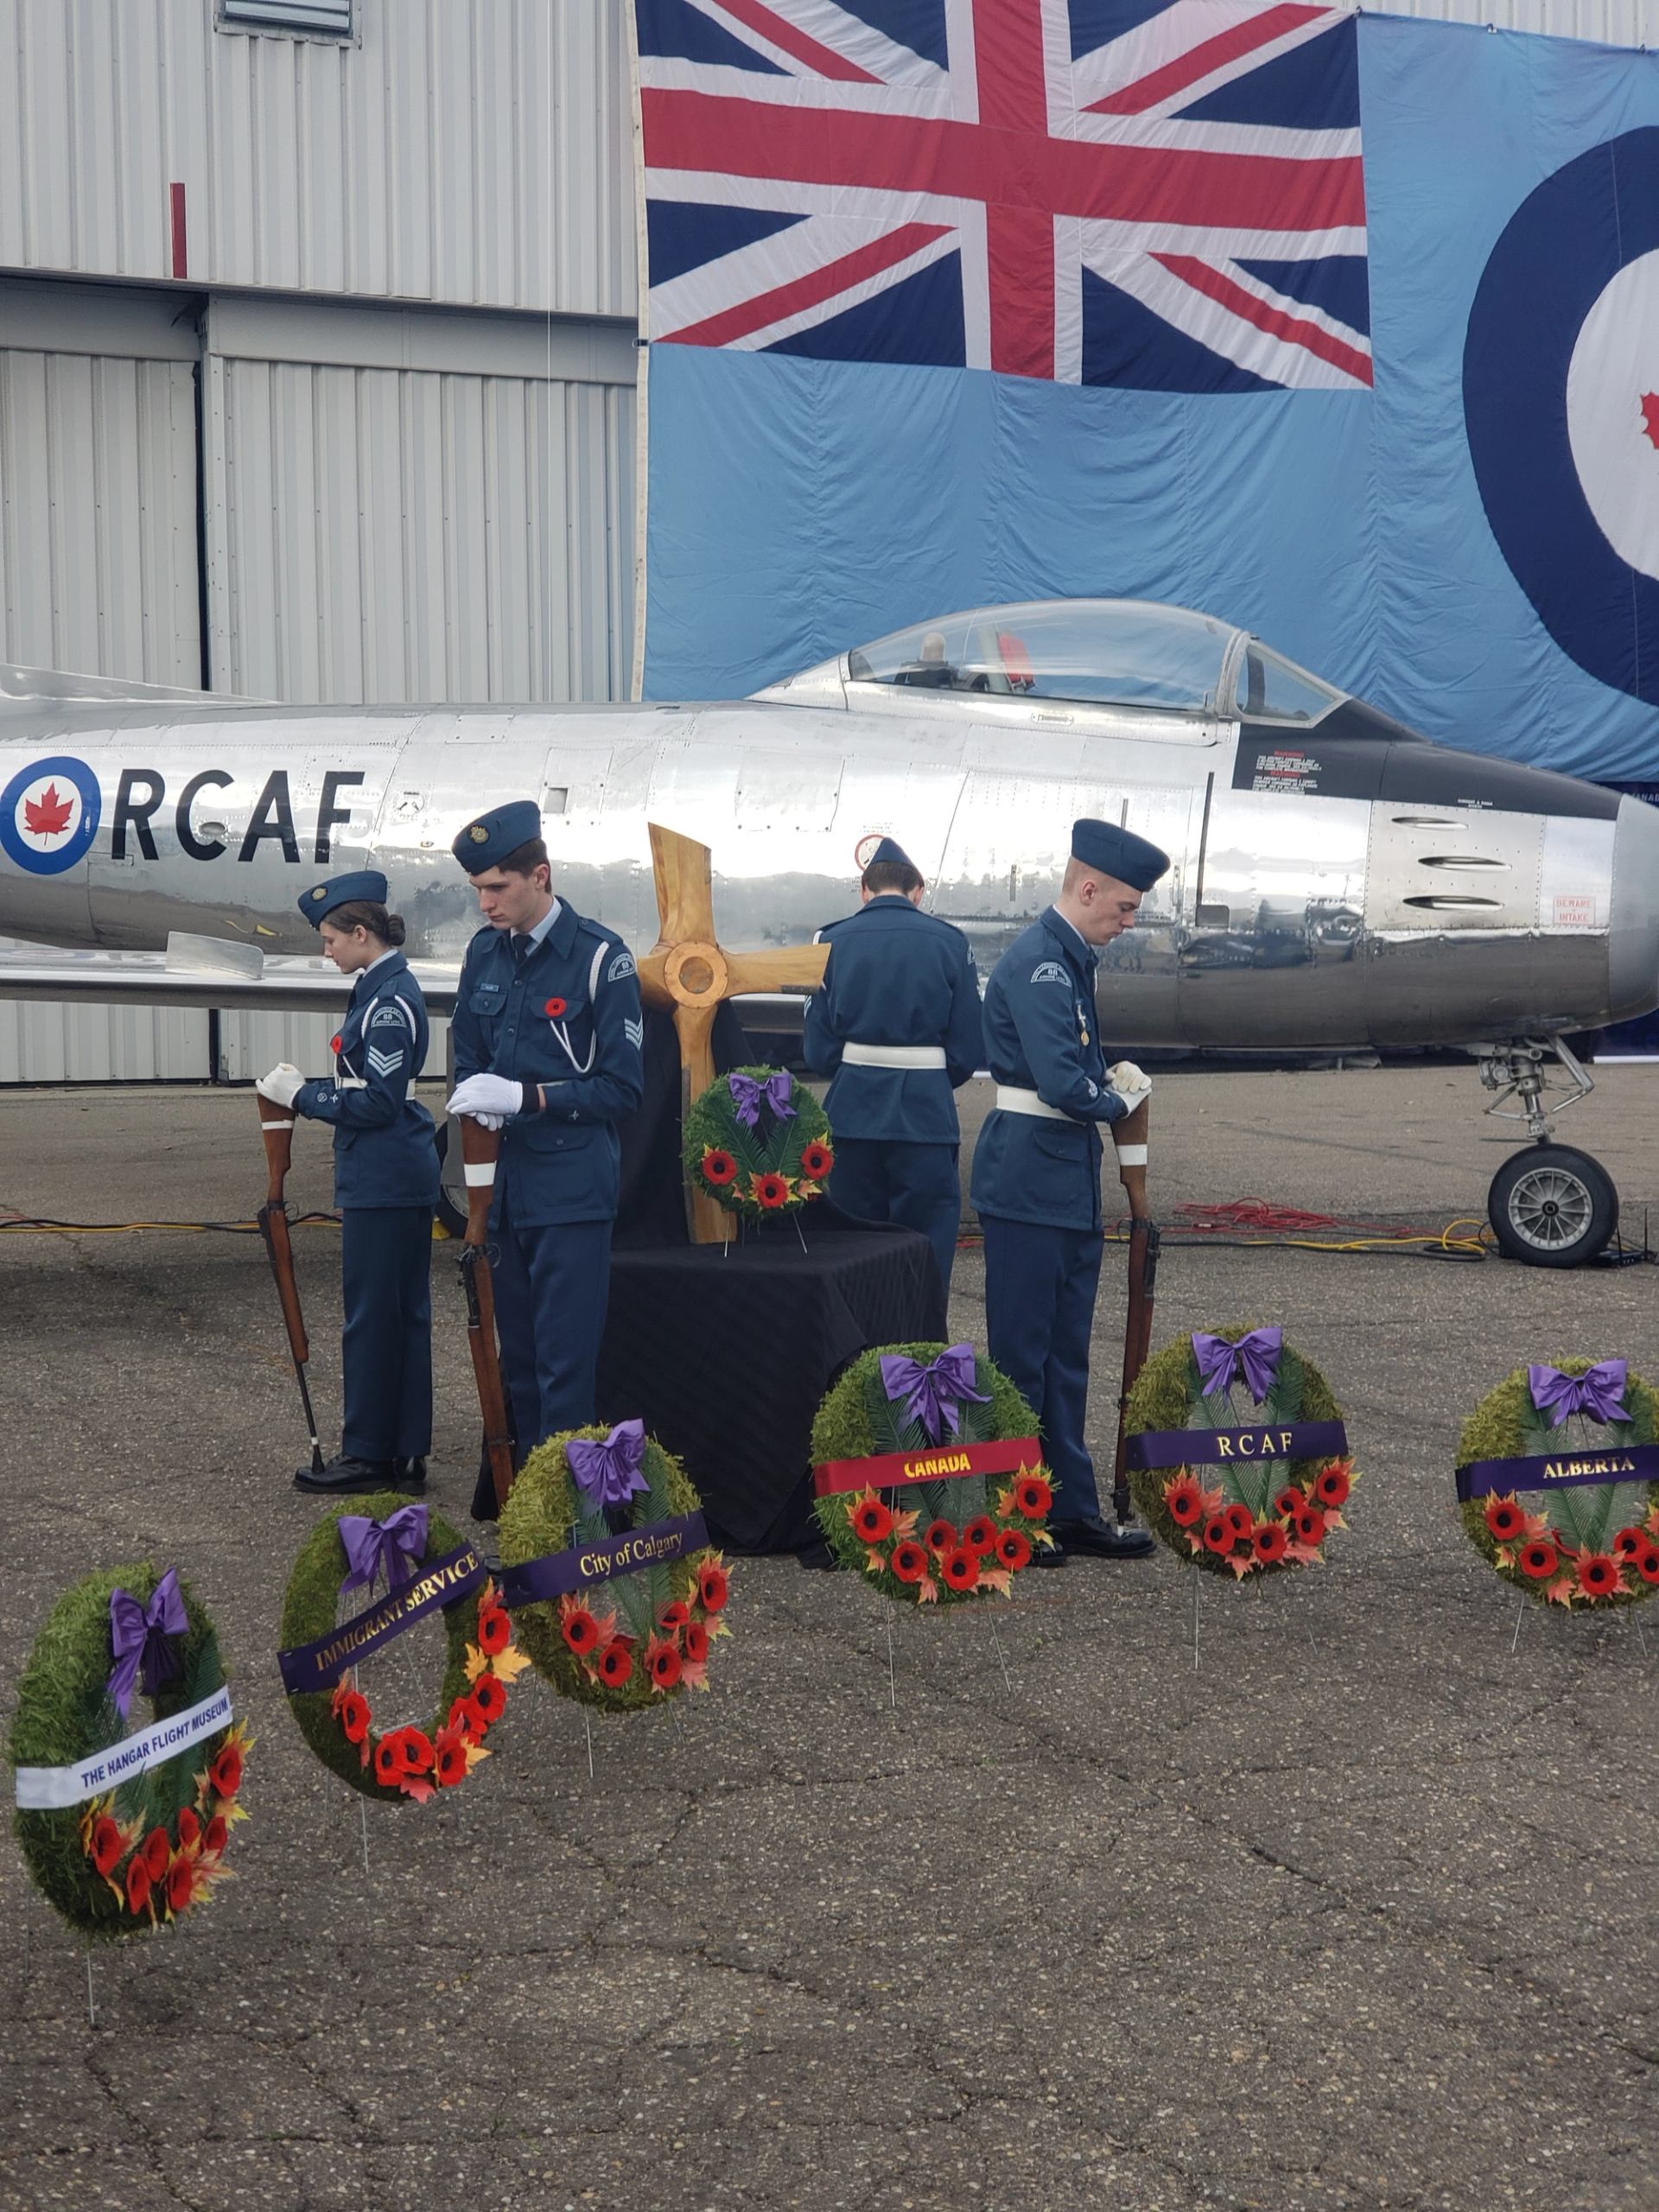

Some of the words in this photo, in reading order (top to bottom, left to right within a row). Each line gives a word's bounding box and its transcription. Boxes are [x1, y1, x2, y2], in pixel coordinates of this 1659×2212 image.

[111, 768, 365, 864] RCAF
[1559, 912, 1589, 922] INTAKE
[1217, 1432, 1293, 1457] RCAF
[904, 1452, 971, 1478] CANADA
[1542, 1456, 1636, 1478] ALBERTA
[580, 1553, 611, 1576] City
[615, 1542, 631, 1566] of
[633, 1532, 683, 1560] Calgary
[314, 1599, 404, 1671] IMMIGRANT
[404, 1552, 479, 1612] SERVICE
[81, 1765, 105, 1788] THE
[107, 1741, 150, 1777] HANGAR
[151, 1721, 190, 1752] FLIGHT
[192, 1697, 229, 1732] MUSEUM
